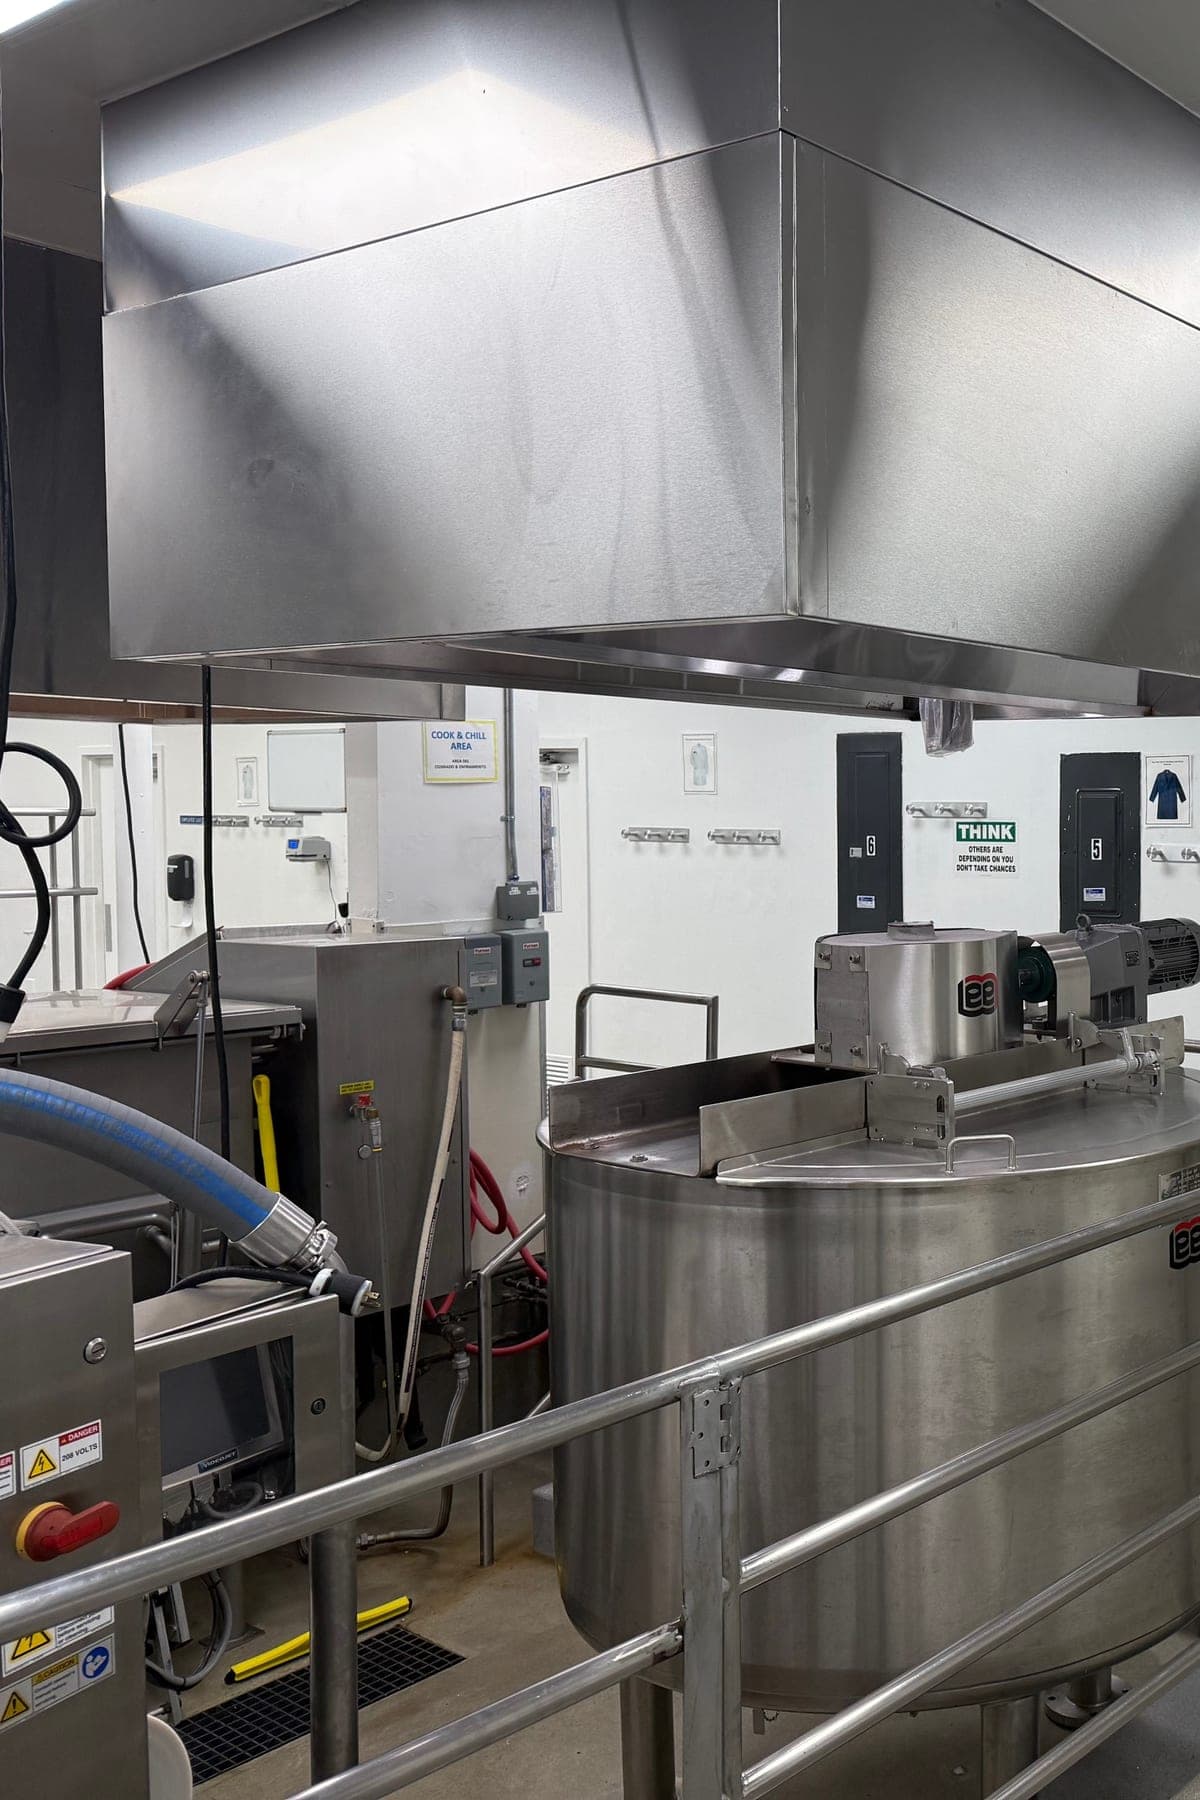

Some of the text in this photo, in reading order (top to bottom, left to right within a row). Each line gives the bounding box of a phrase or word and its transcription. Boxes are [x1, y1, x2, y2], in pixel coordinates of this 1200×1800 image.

[431, 731, 487, 740] COOK & CHILL
[450, 742, 472, 750] AREA
[958, 824, 1014, 840] THINK
[868, 837, 874, 854] 6
[1093, 840, 1100, 858] 5
[68, 1425, 98, 1441] DANGER
[62, 1443, 98, 1462] 208 VOLTS
